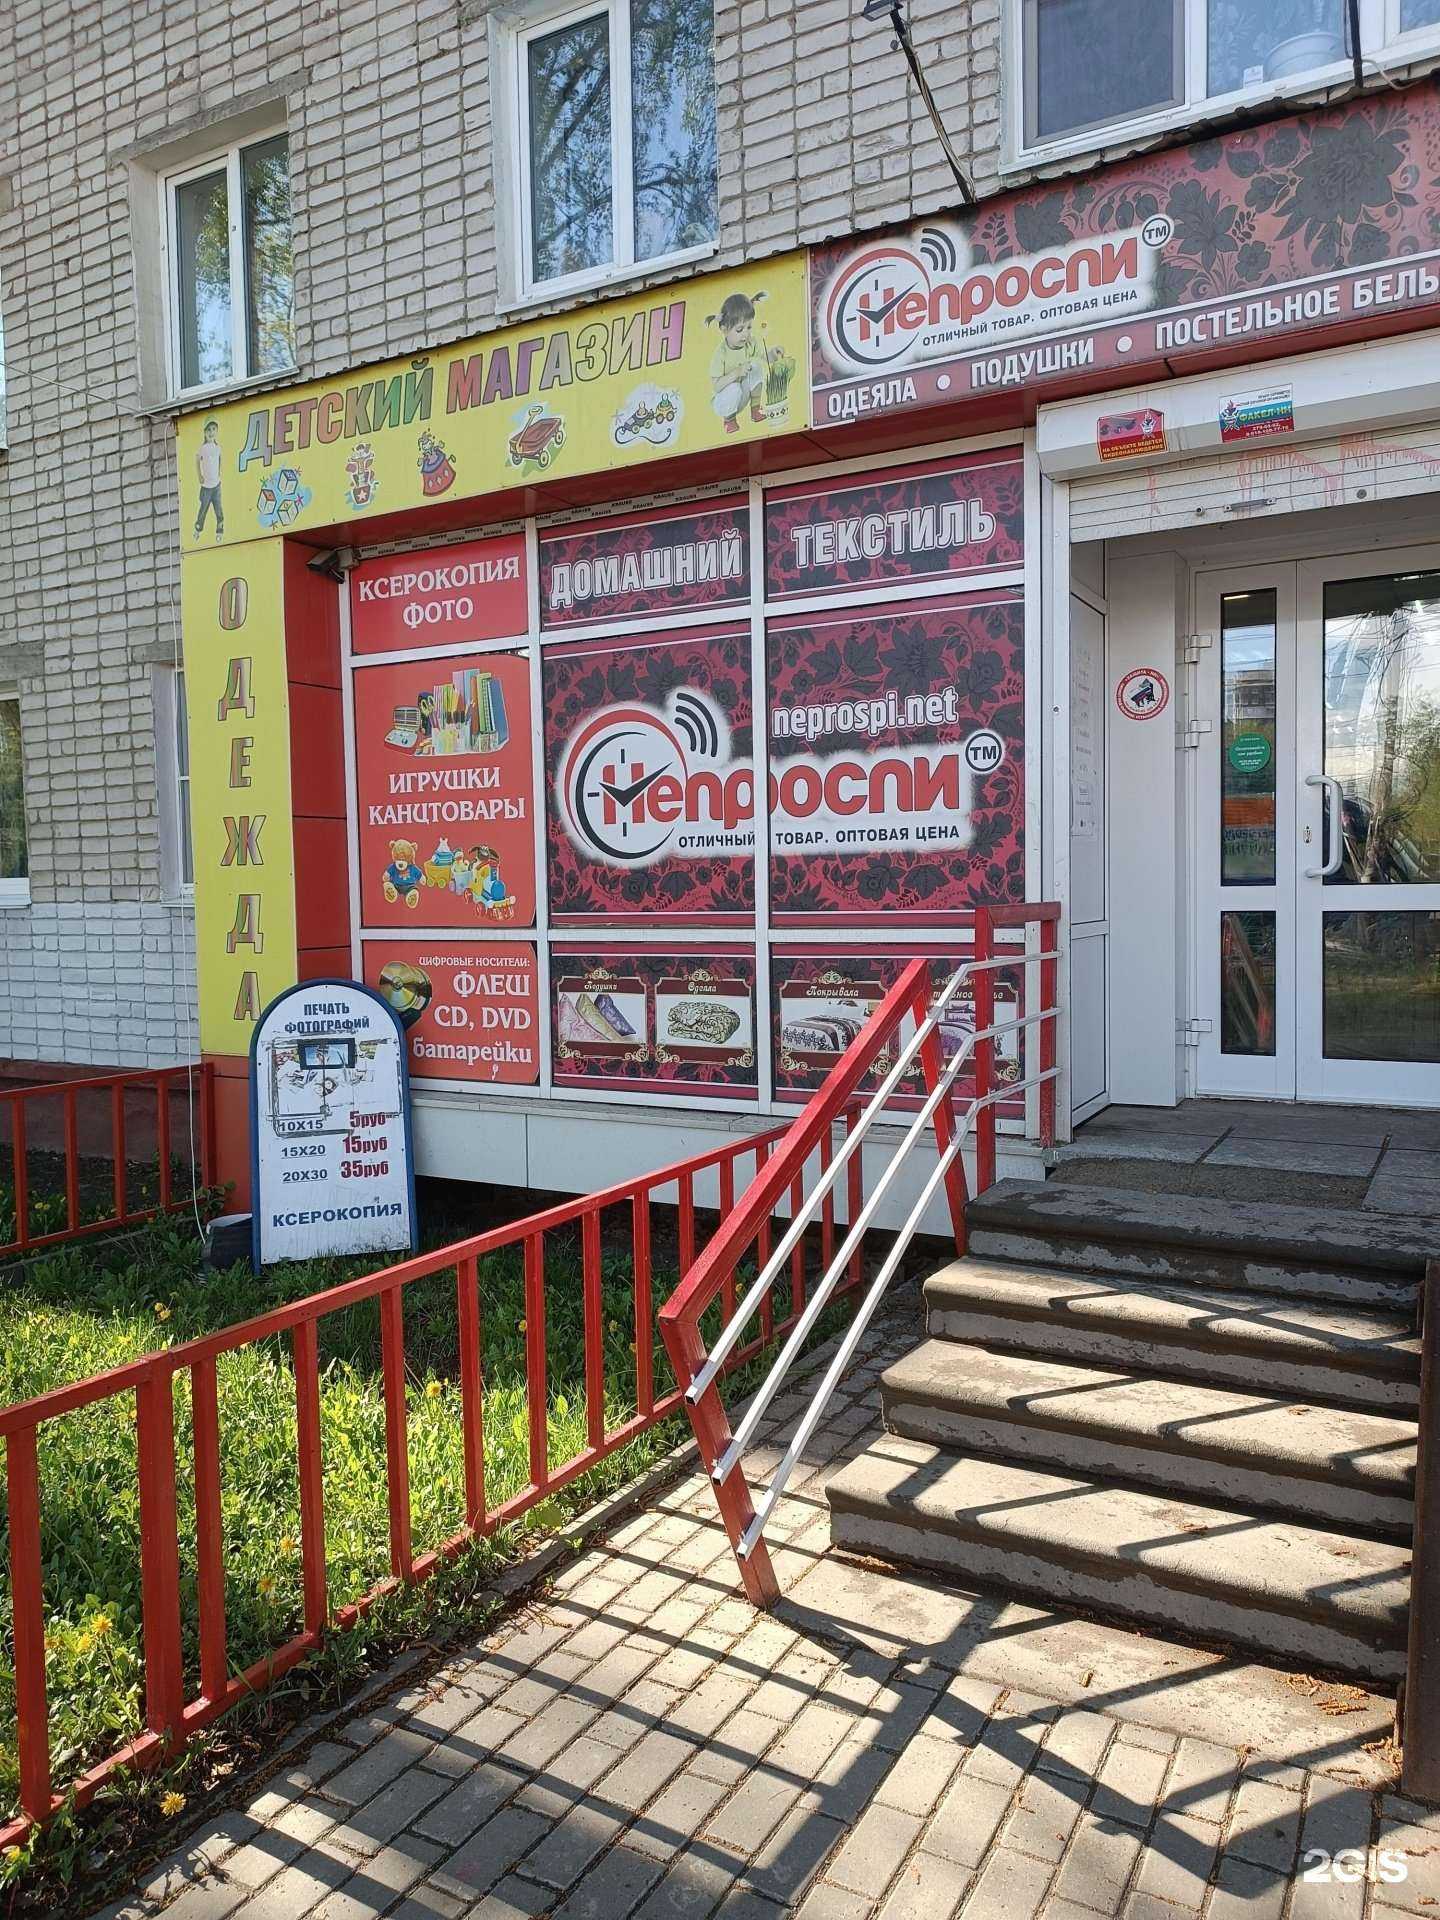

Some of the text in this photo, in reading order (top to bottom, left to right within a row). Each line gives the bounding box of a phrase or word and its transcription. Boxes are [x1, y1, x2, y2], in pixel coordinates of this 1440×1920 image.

[922, 289, 1138, 346] ОТЛИЧНЫЙ ТОВАР. ОПТОВАЯ ЦЕНА
[828, 267, 1439, 418] ОДЕЯЛА ПОДУШКИ ПОСТЕЛЬНОЕ БЕЛЬ
[238, 301, 687, 473] ДЕТСКИЙ МАГАЗИН
[550, 499, 996, 609] ДОМАШНИЙ ТЕКСТИЛЬ
[358, 555, 520, 602] КСЕРОКОПИЯ
[402, 597, 474, 629] ФОТО
[772, 686, 958, 740] neprospi.net
[388, 766, 500, 796] ИГРУШКИ
[218, 577, 266, 1020] ОДЕЖДА
[368, 797, 526, 826] КАНЦТОВАРЫ
[679, 825, 959, 848] ОТЛИЧНЫЙ ТОВАР. ОПТОВАЯ ЦЕНА
[419, 956, 530, 967] ЦИФРОВЫЕ НОСИТЕЛИ:
[453, 971, 530, 998] ФЛЕШ
[303, 1002, 350, 1016] ПЕЧАТЬ
[434, 1005, 531, 1031] CD, DVD
[284, 1017, 370, 1034] ФОТОГРАФИЙ
[413, 1036, 532, 1066] батарейки
[349, 1111, 386, 1128] 5руб
[342, 1136, 388, 1154] 15руб
[340, 1160, 389, 1179] 35руб
[272, 1203, 402, 1228] КСЕРОКОПИЯ
